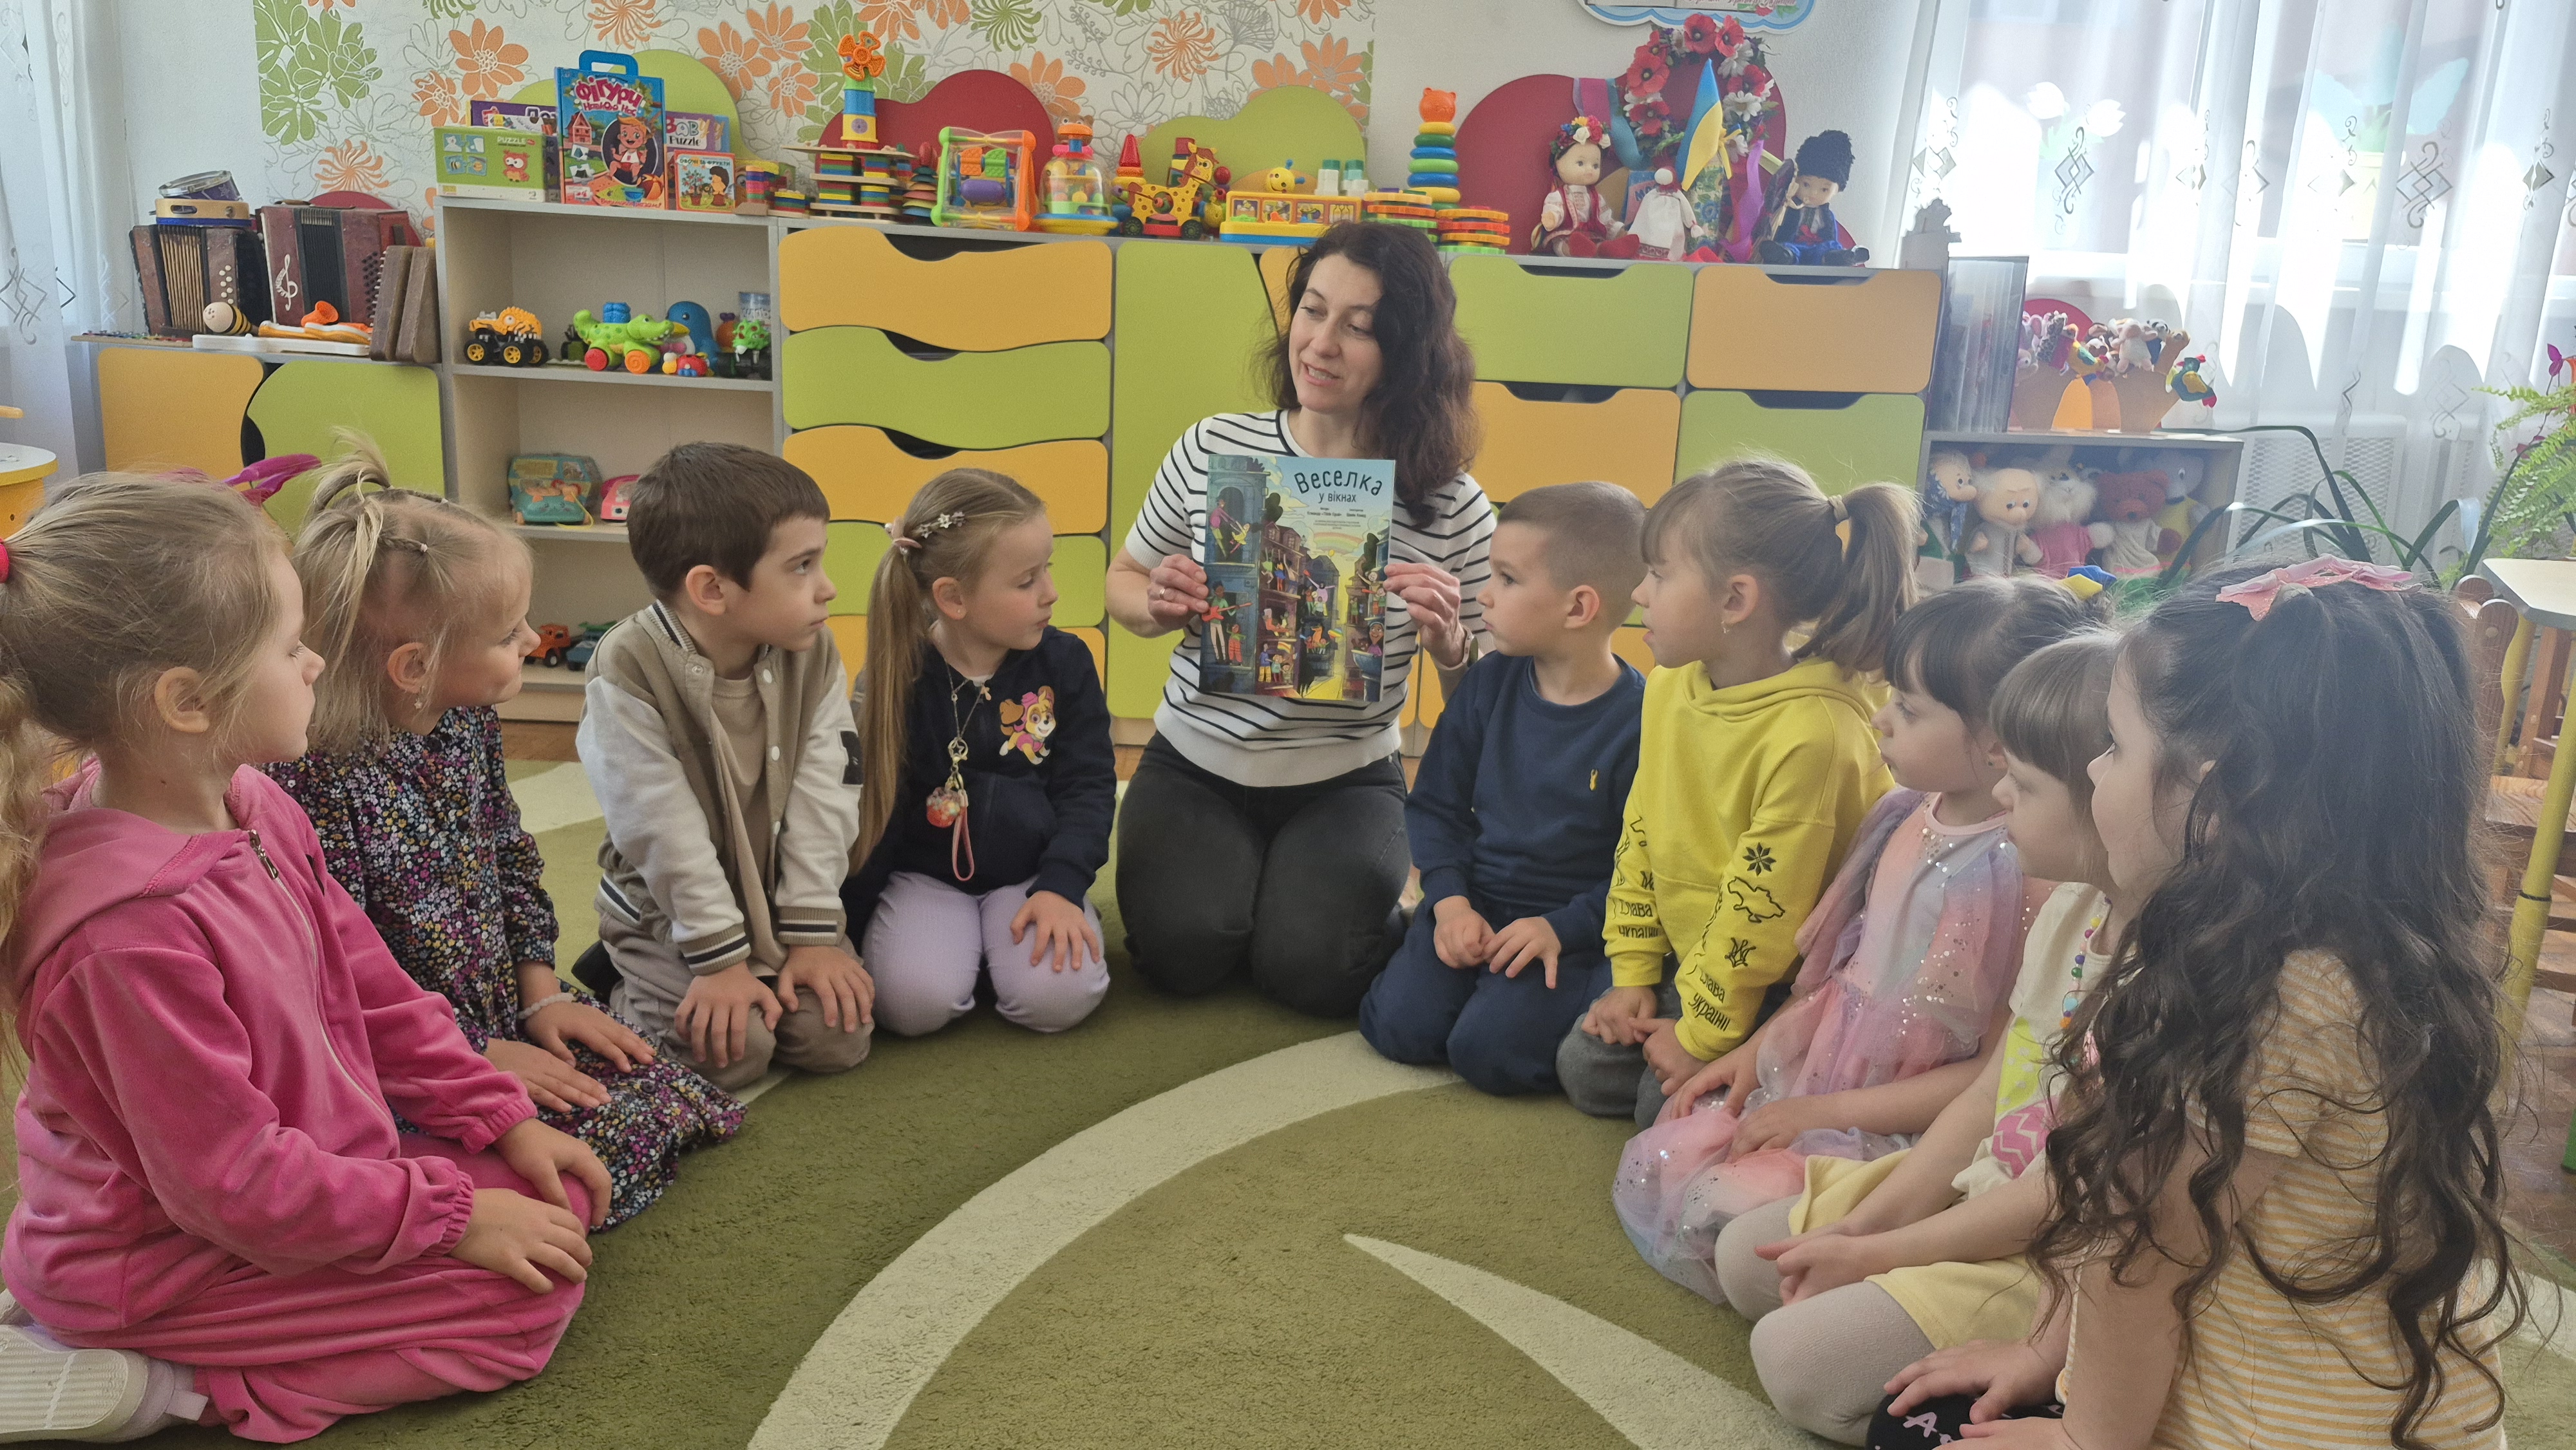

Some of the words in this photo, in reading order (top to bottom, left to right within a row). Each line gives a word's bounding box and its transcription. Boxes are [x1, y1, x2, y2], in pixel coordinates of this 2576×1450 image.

[497, 136, 527, 145] PUZZLE
[669, 135, 701, 147] Puzzle
[1294, 470, 1383, 496] Веселка
[1318, 493, 1325, 504] у
[1327, 491, 1356, 502] вікнах
